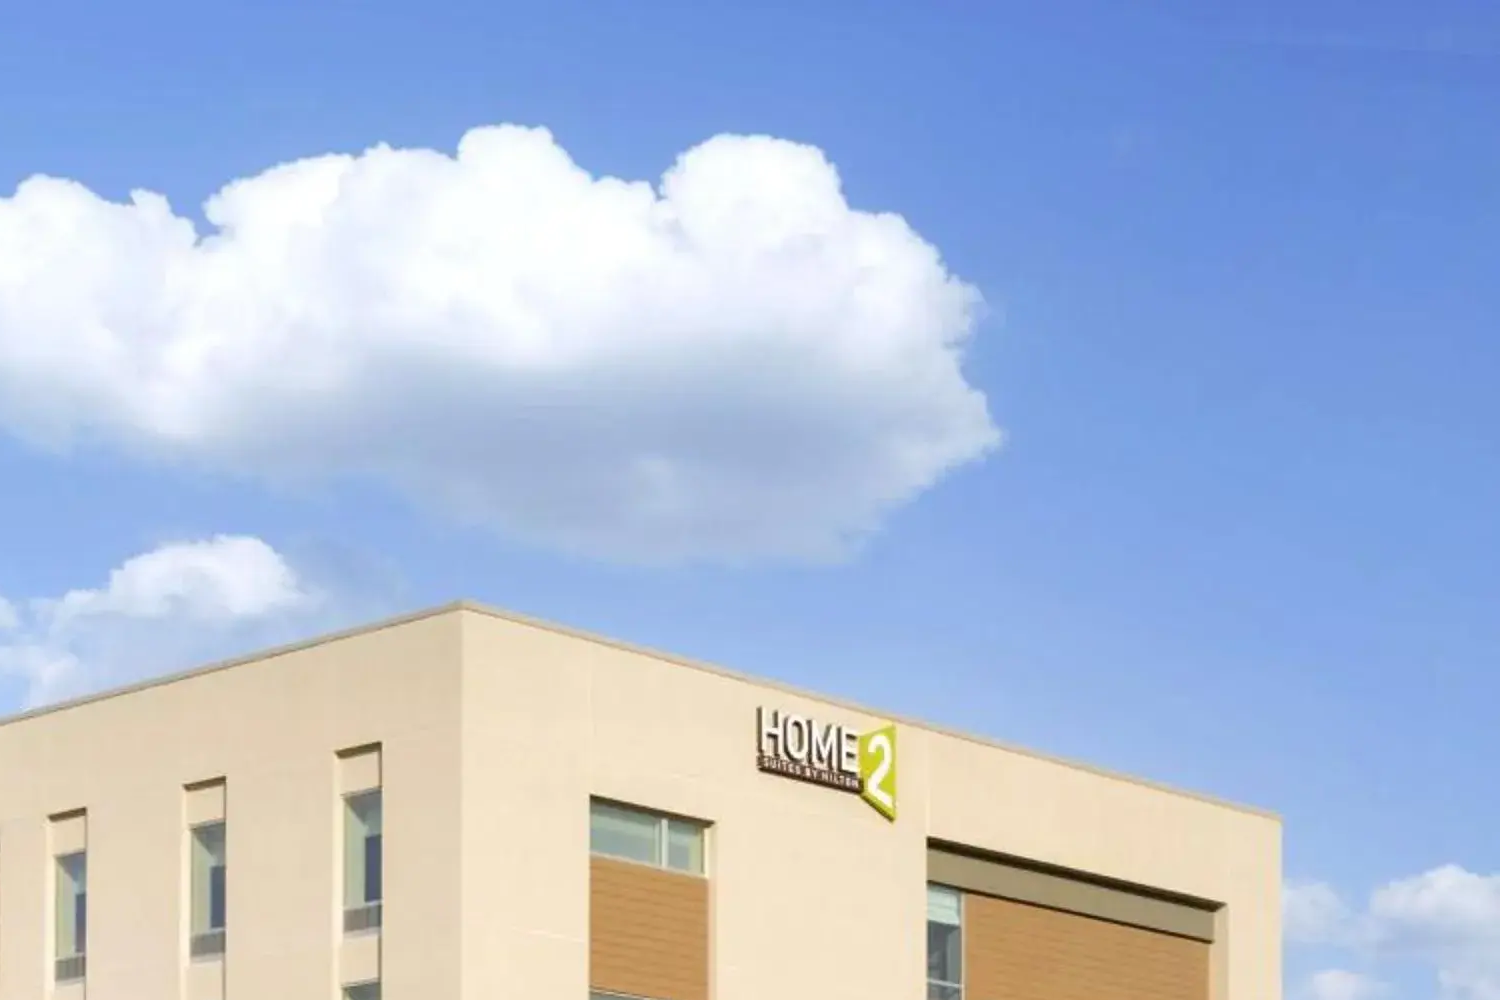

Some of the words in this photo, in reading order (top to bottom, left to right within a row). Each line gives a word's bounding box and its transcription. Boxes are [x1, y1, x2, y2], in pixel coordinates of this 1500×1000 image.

[757, 706, 859, 774] HOME
[867, 734, 893, 808] 2
[763, 756, 801, 775] SUITES
